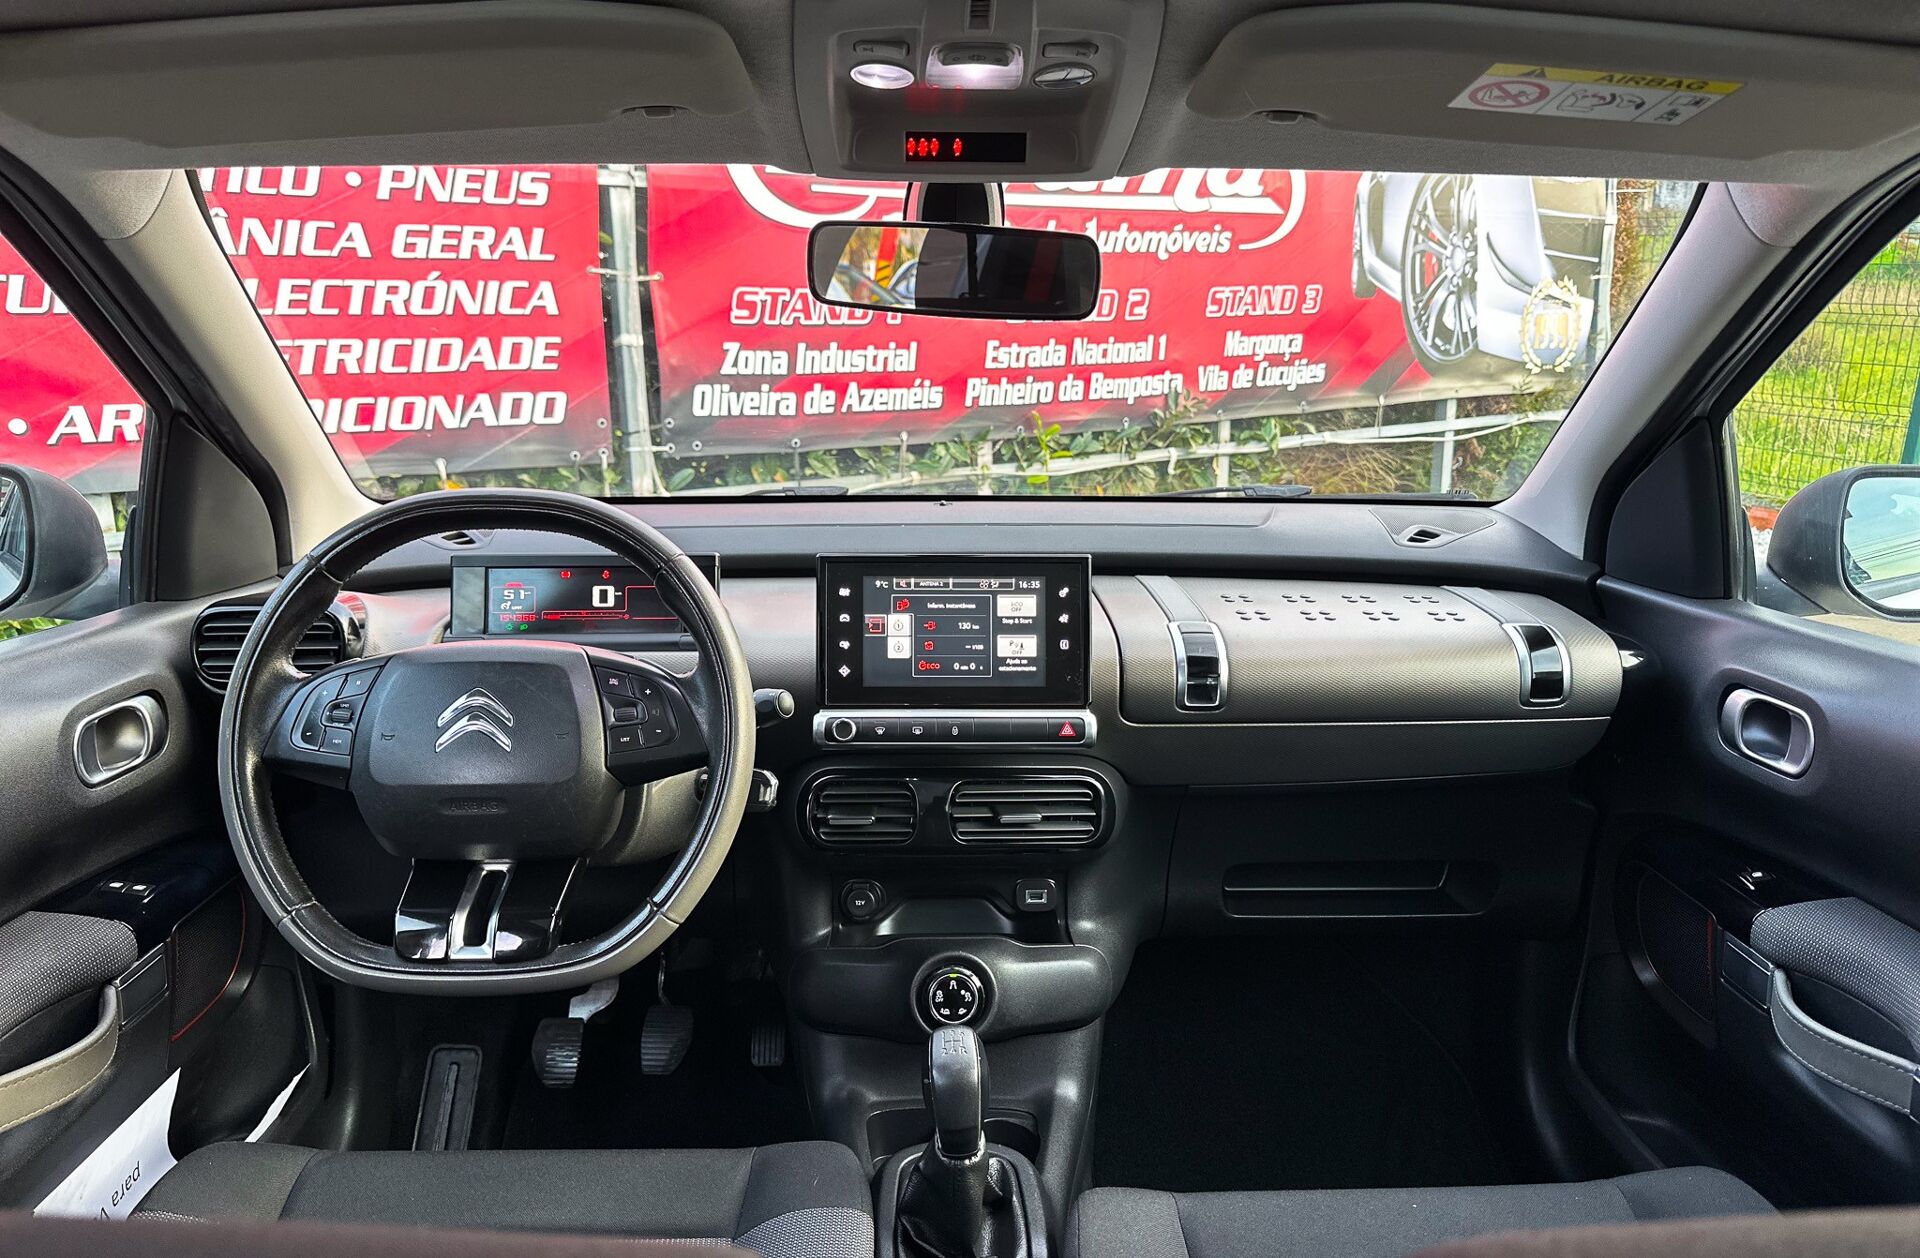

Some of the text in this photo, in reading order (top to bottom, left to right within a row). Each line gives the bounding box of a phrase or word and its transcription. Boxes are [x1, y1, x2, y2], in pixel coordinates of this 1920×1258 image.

[1593, 73, 1709, 90] AIRBAG
[376, 166, 550, 206] PNEUS
[391, 223, 556, 262] GERAL
[1125, 287, 1150, 322] 2
[1205, 284, 1323, 318] STAND 3
[719, 341, 918, 376] Zona Industrial
[984, 334, 1167, 370] Estrada Nacional 1
[1223, 330, 1303, 362] Margonça
[964, 370, 1184, 407] Pinheiro da Bemposta
[1197, 359, 1326, 393] Vila de Cucujães
[692, 380, 944, 418] Oliveira de Azeméis
[46, 403, 144, 446] AR
[592, 585, 615, 607] 0
[875, 580, 889, 589] 9°C
[1018, 580, 1041, 589] 16:35
[953, 662, 959, 670] 0
[970, 662, 976, 670] 0
[448, 801, 499, 813] AIRBAG
[111, 1161, 142, 1206] para
